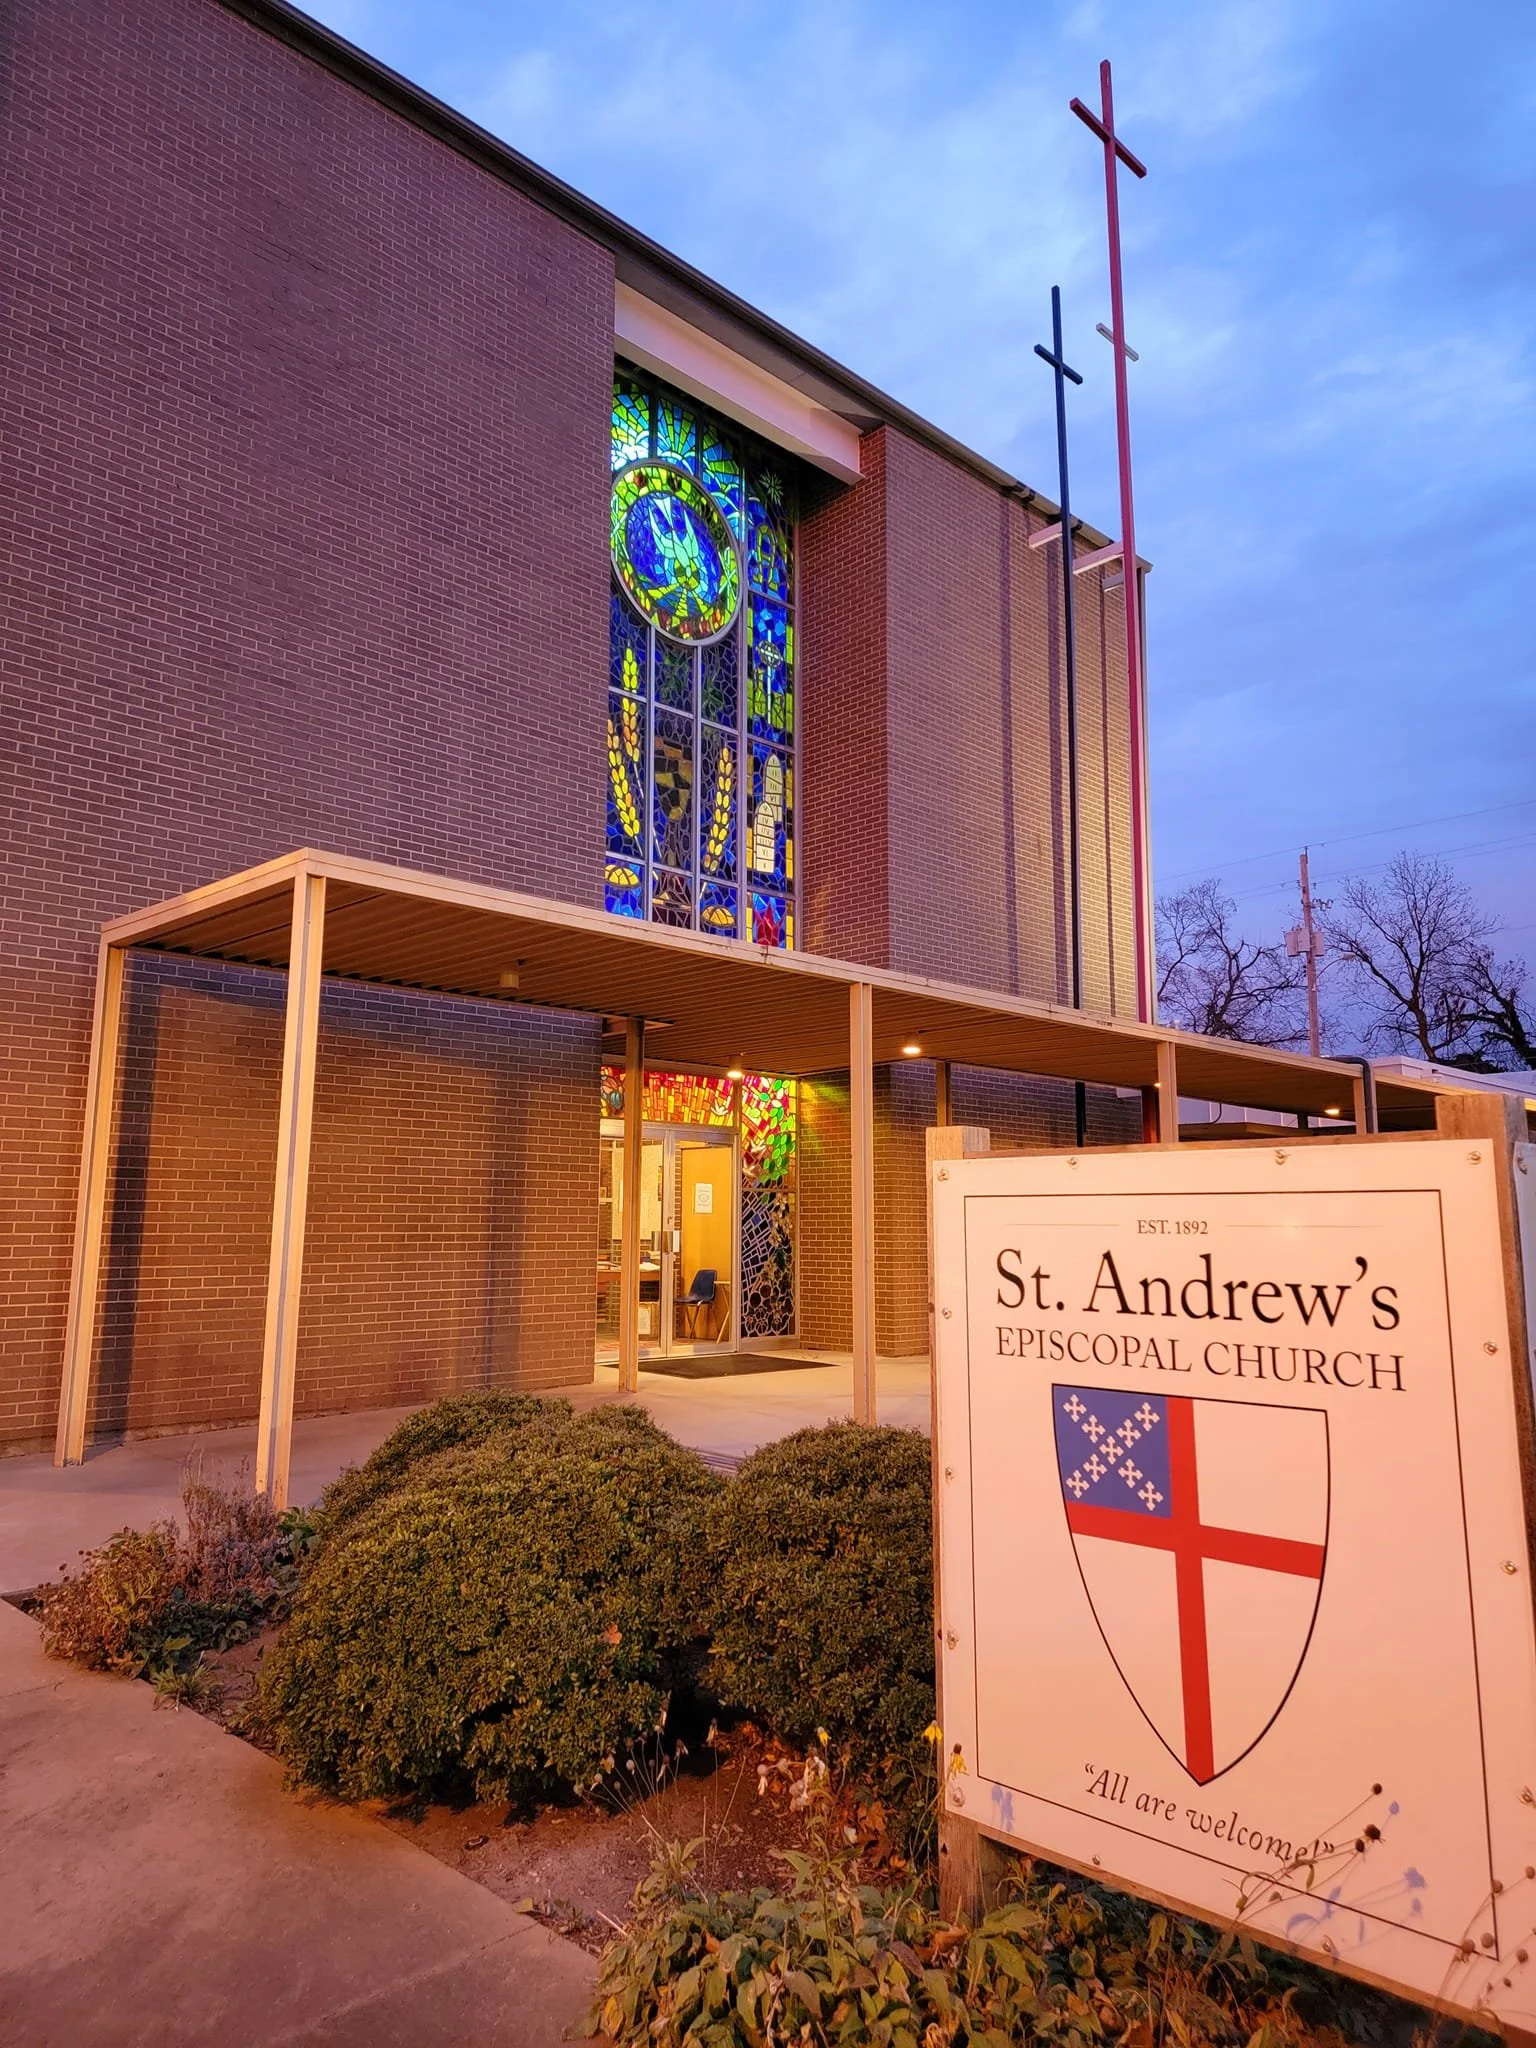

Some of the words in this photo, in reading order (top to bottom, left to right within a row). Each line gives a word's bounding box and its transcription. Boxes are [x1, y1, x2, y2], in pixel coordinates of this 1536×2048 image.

[1136, 1219, 1171, 1235] EST.
[1174, 1220, 1209, 1236] 1892
[996, 1248, 1065, 1312] St.
[1082, 1249, 1401, 1331] Andrew’s
[995, 1326, 1193, 1373] EPISCOPAL
[1203, 1341, 1408, 1392] CHURCH
[1084, 1763, 1129, 1805] “All
[1135, 1792, 1177, 1822] are
